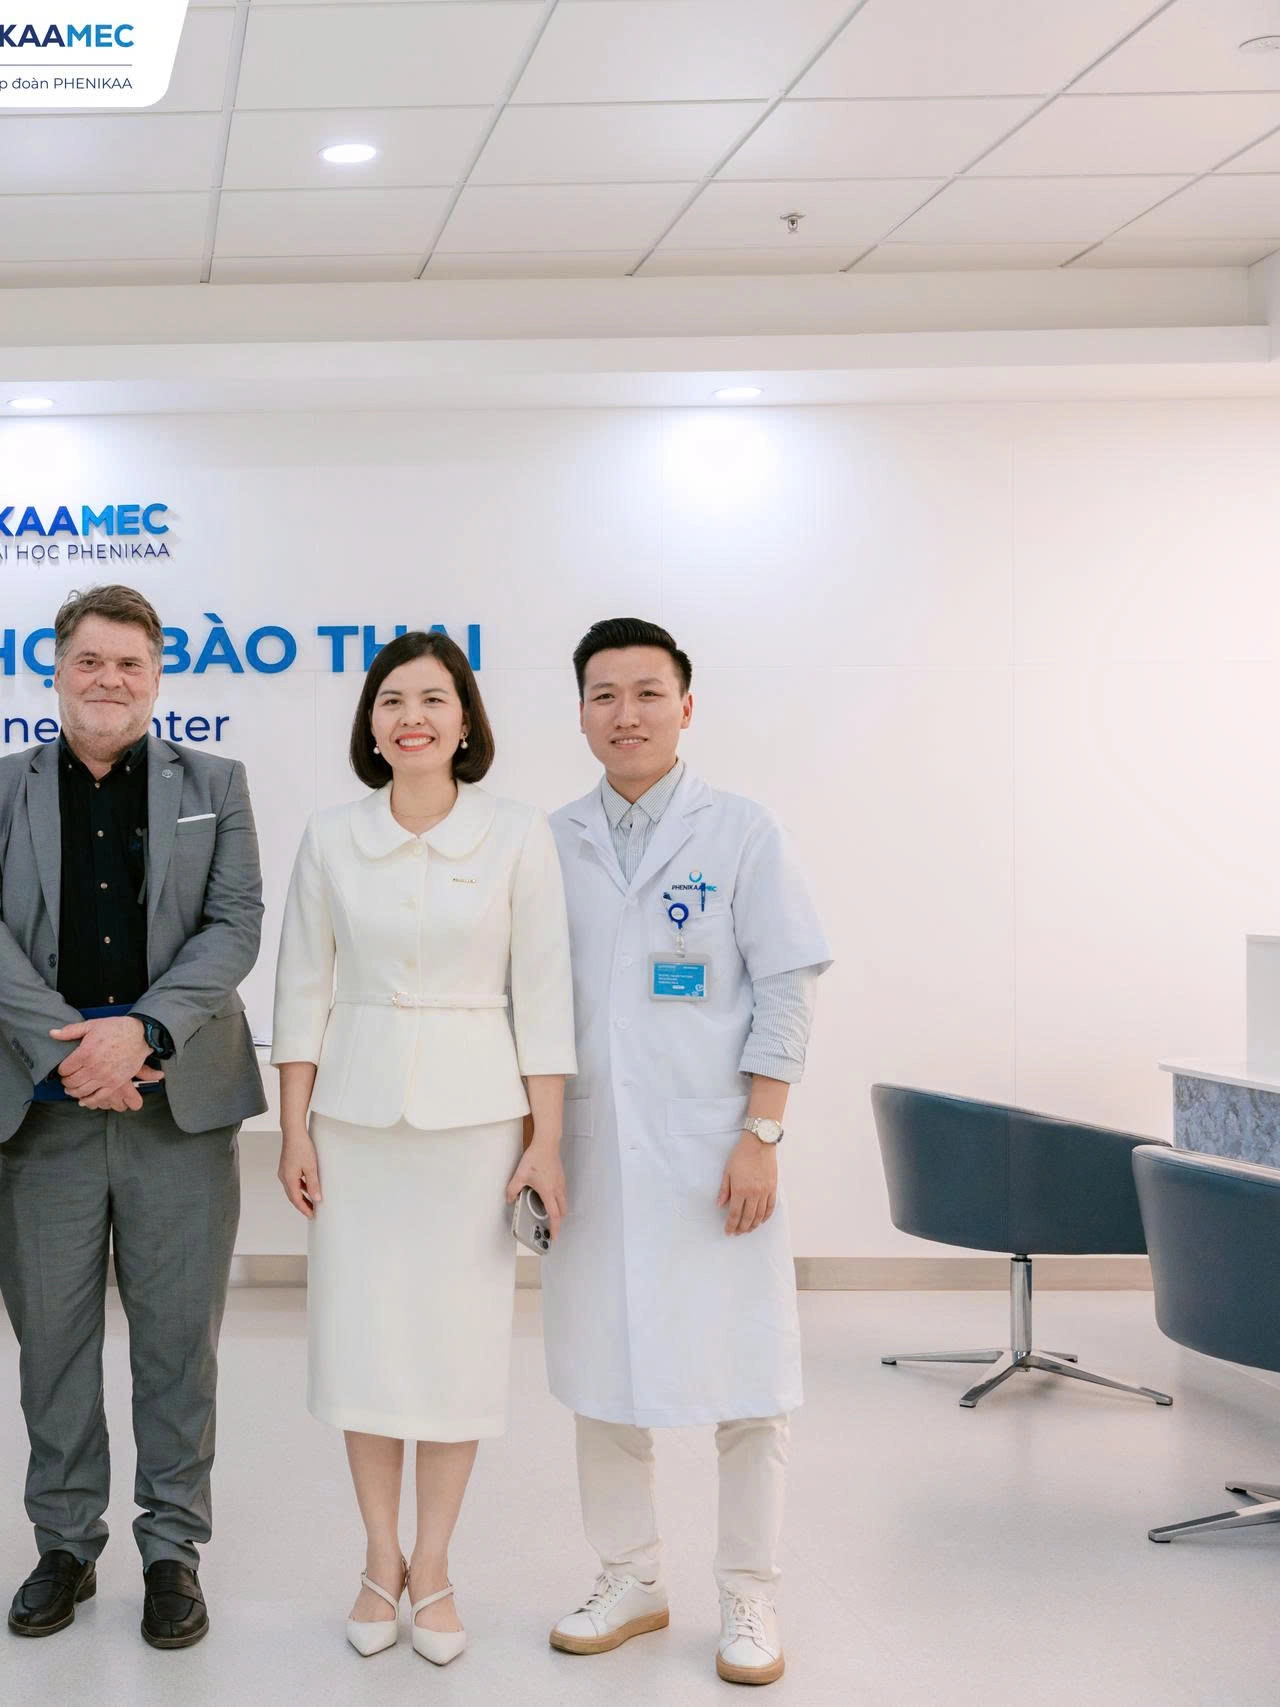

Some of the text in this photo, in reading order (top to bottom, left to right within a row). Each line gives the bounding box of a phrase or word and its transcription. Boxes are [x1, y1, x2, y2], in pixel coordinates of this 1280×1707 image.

[17, 544, 59, 565] HỌC
[67, 542, 171, 561] PHENIKAA
[163, 612, 298, 674] BÀO
[317, 624, 481, 673] THI
